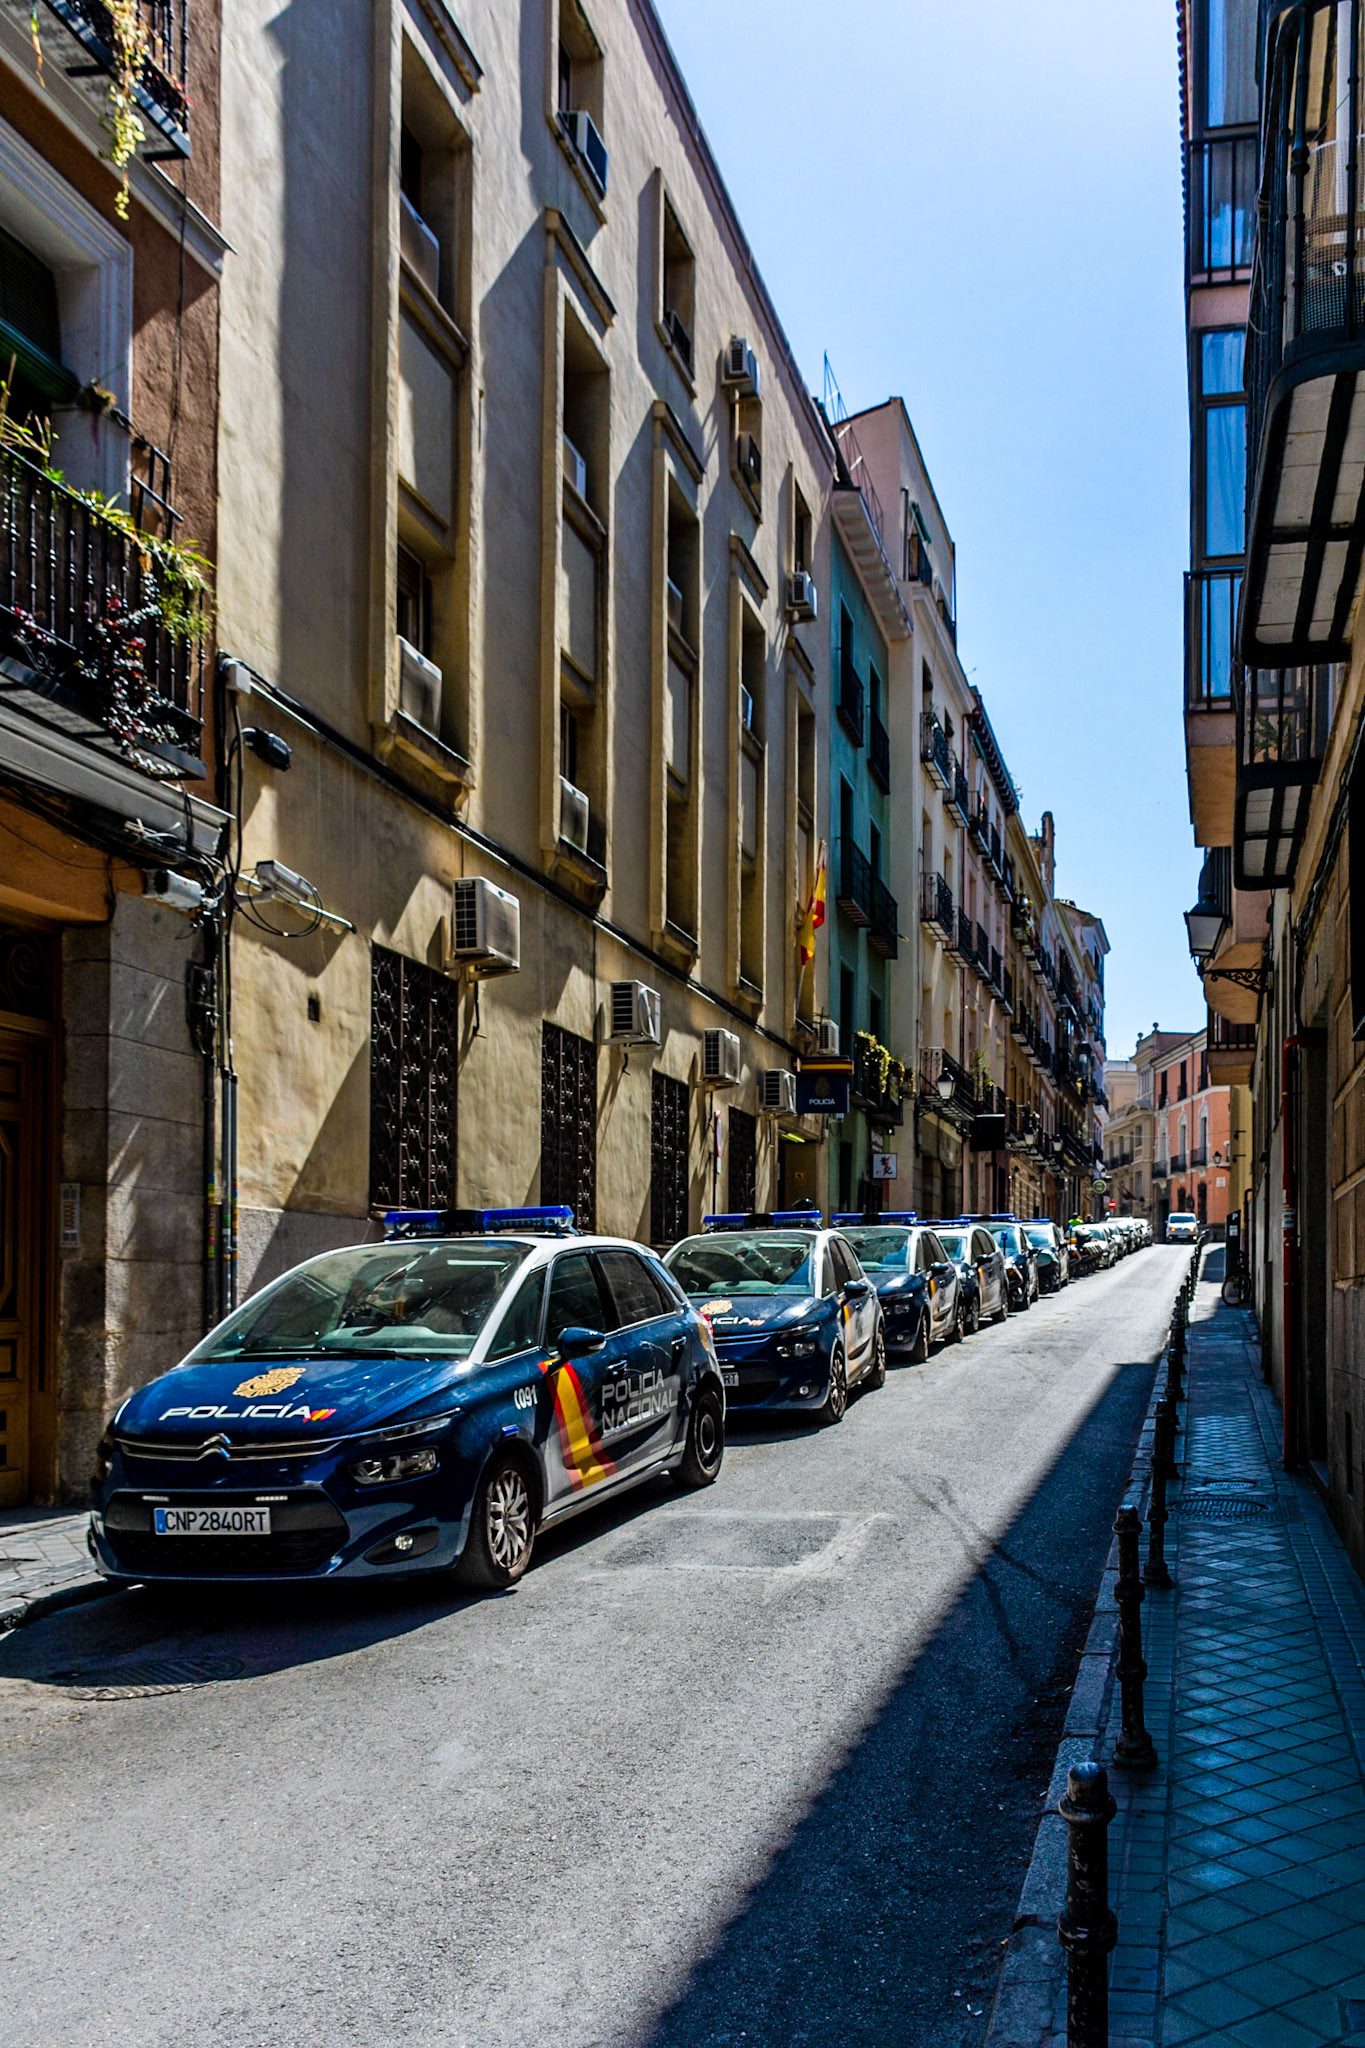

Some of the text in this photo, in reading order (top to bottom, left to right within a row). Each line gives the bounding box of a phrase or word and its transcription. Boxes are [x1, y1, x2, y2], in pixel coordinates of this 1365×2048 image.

[602, 1366, 665, 1407] POLICÍA
[158, 1403, 312, 1421] POLICÍA
[602, 1389, 678, 1430] NACIONAL
